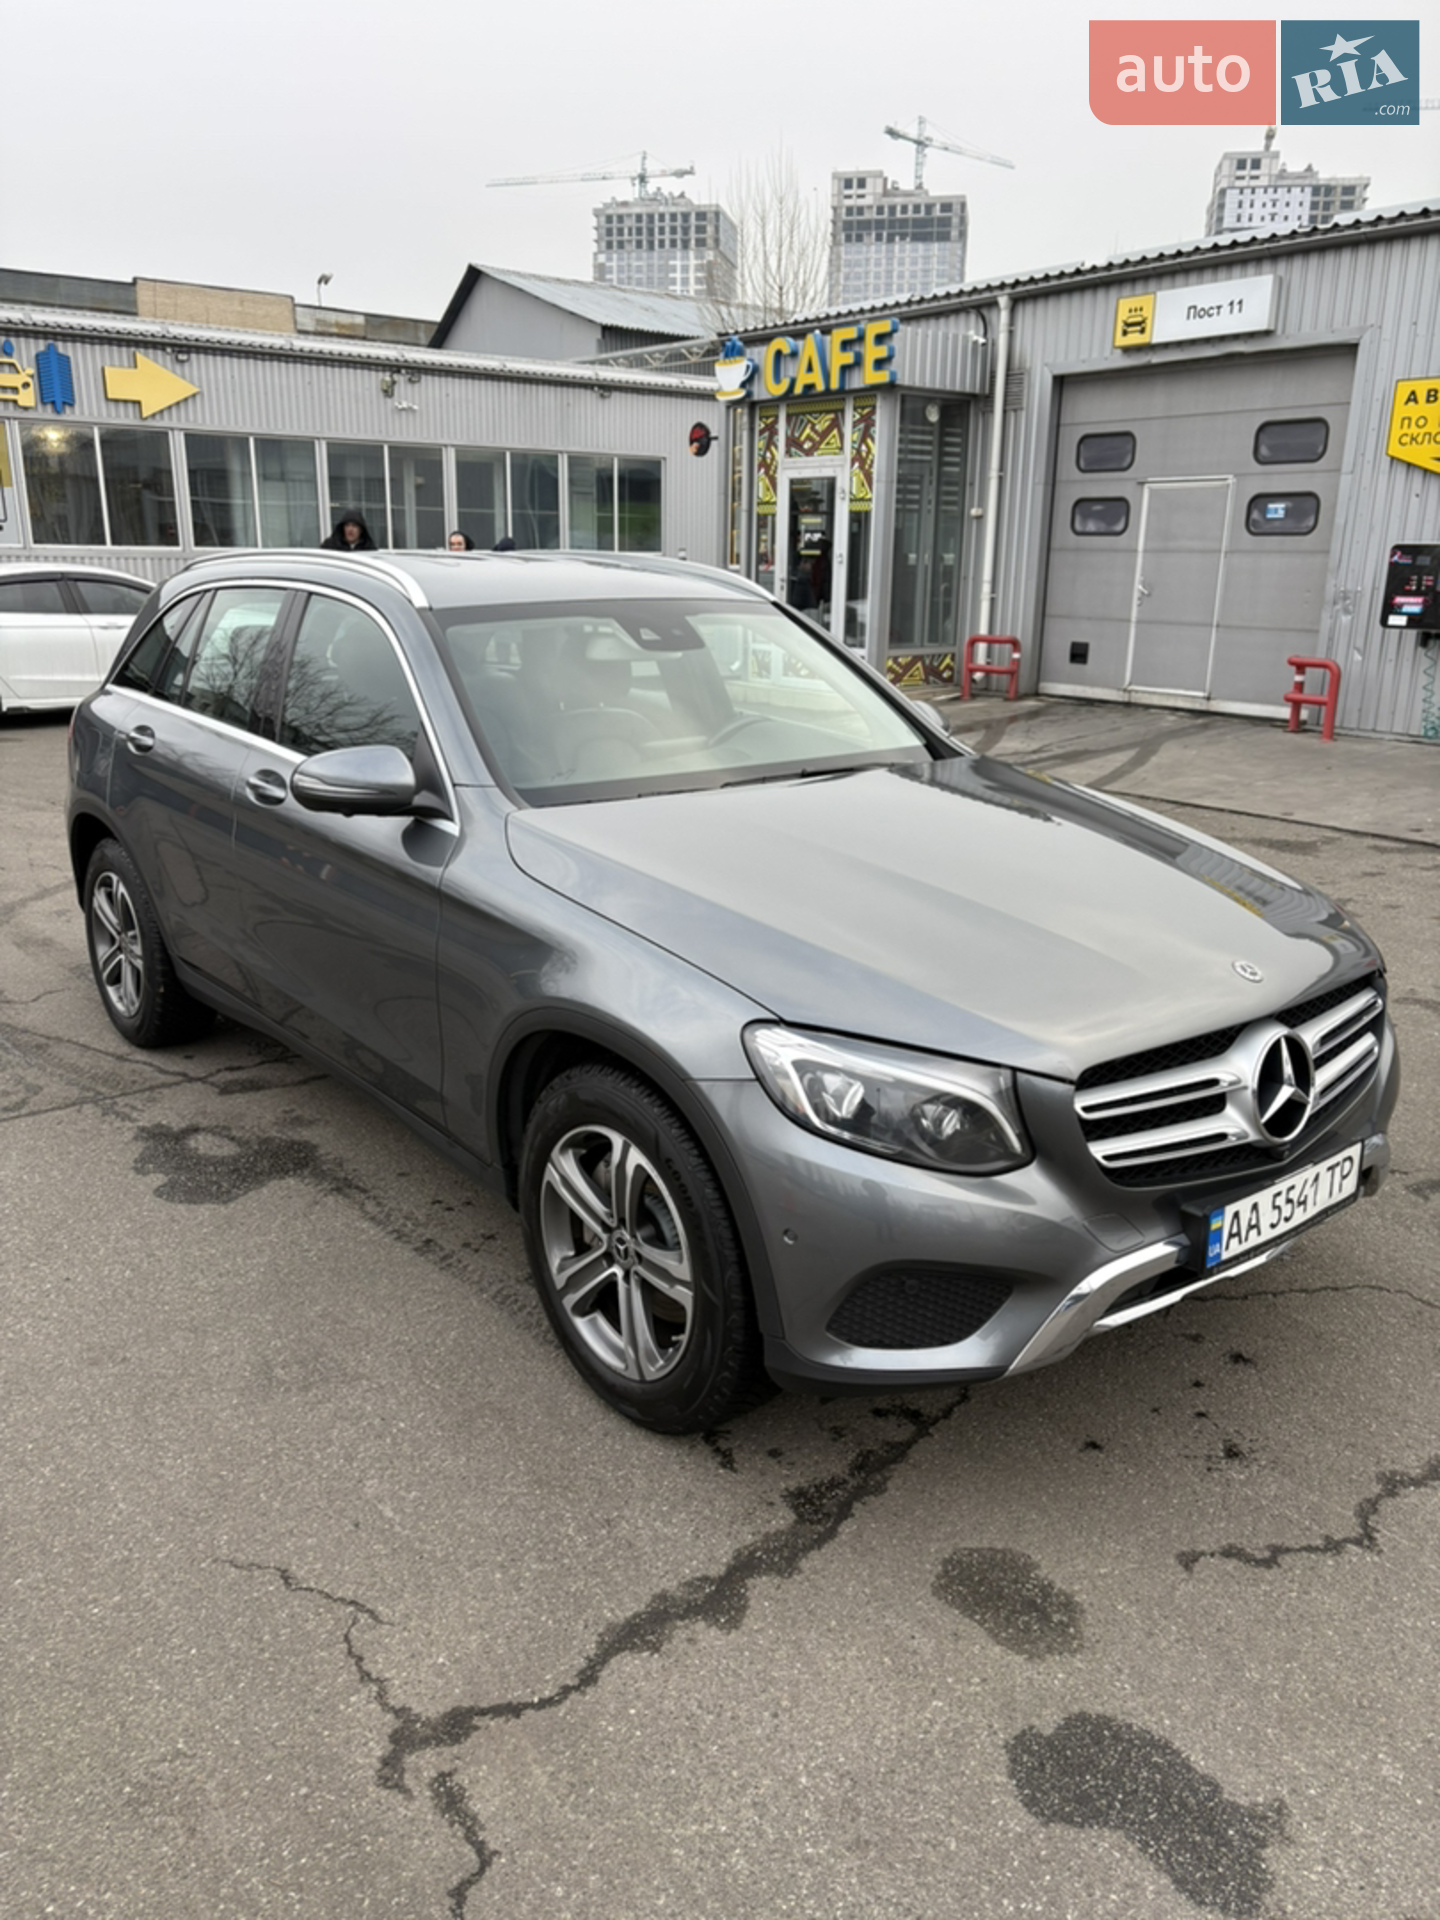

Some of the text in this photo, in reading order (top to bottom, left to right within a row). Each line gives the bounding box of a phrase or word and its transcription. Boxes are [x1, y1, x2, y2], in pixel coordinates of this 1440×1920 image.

[1186, 298, 1244, 321] Пост 11
[765, 318, 899, 396] CAFE
[1224, 1154, 1354, 1252] AA 5541 TP
[1208, 1243, 1221, 1258] UA
